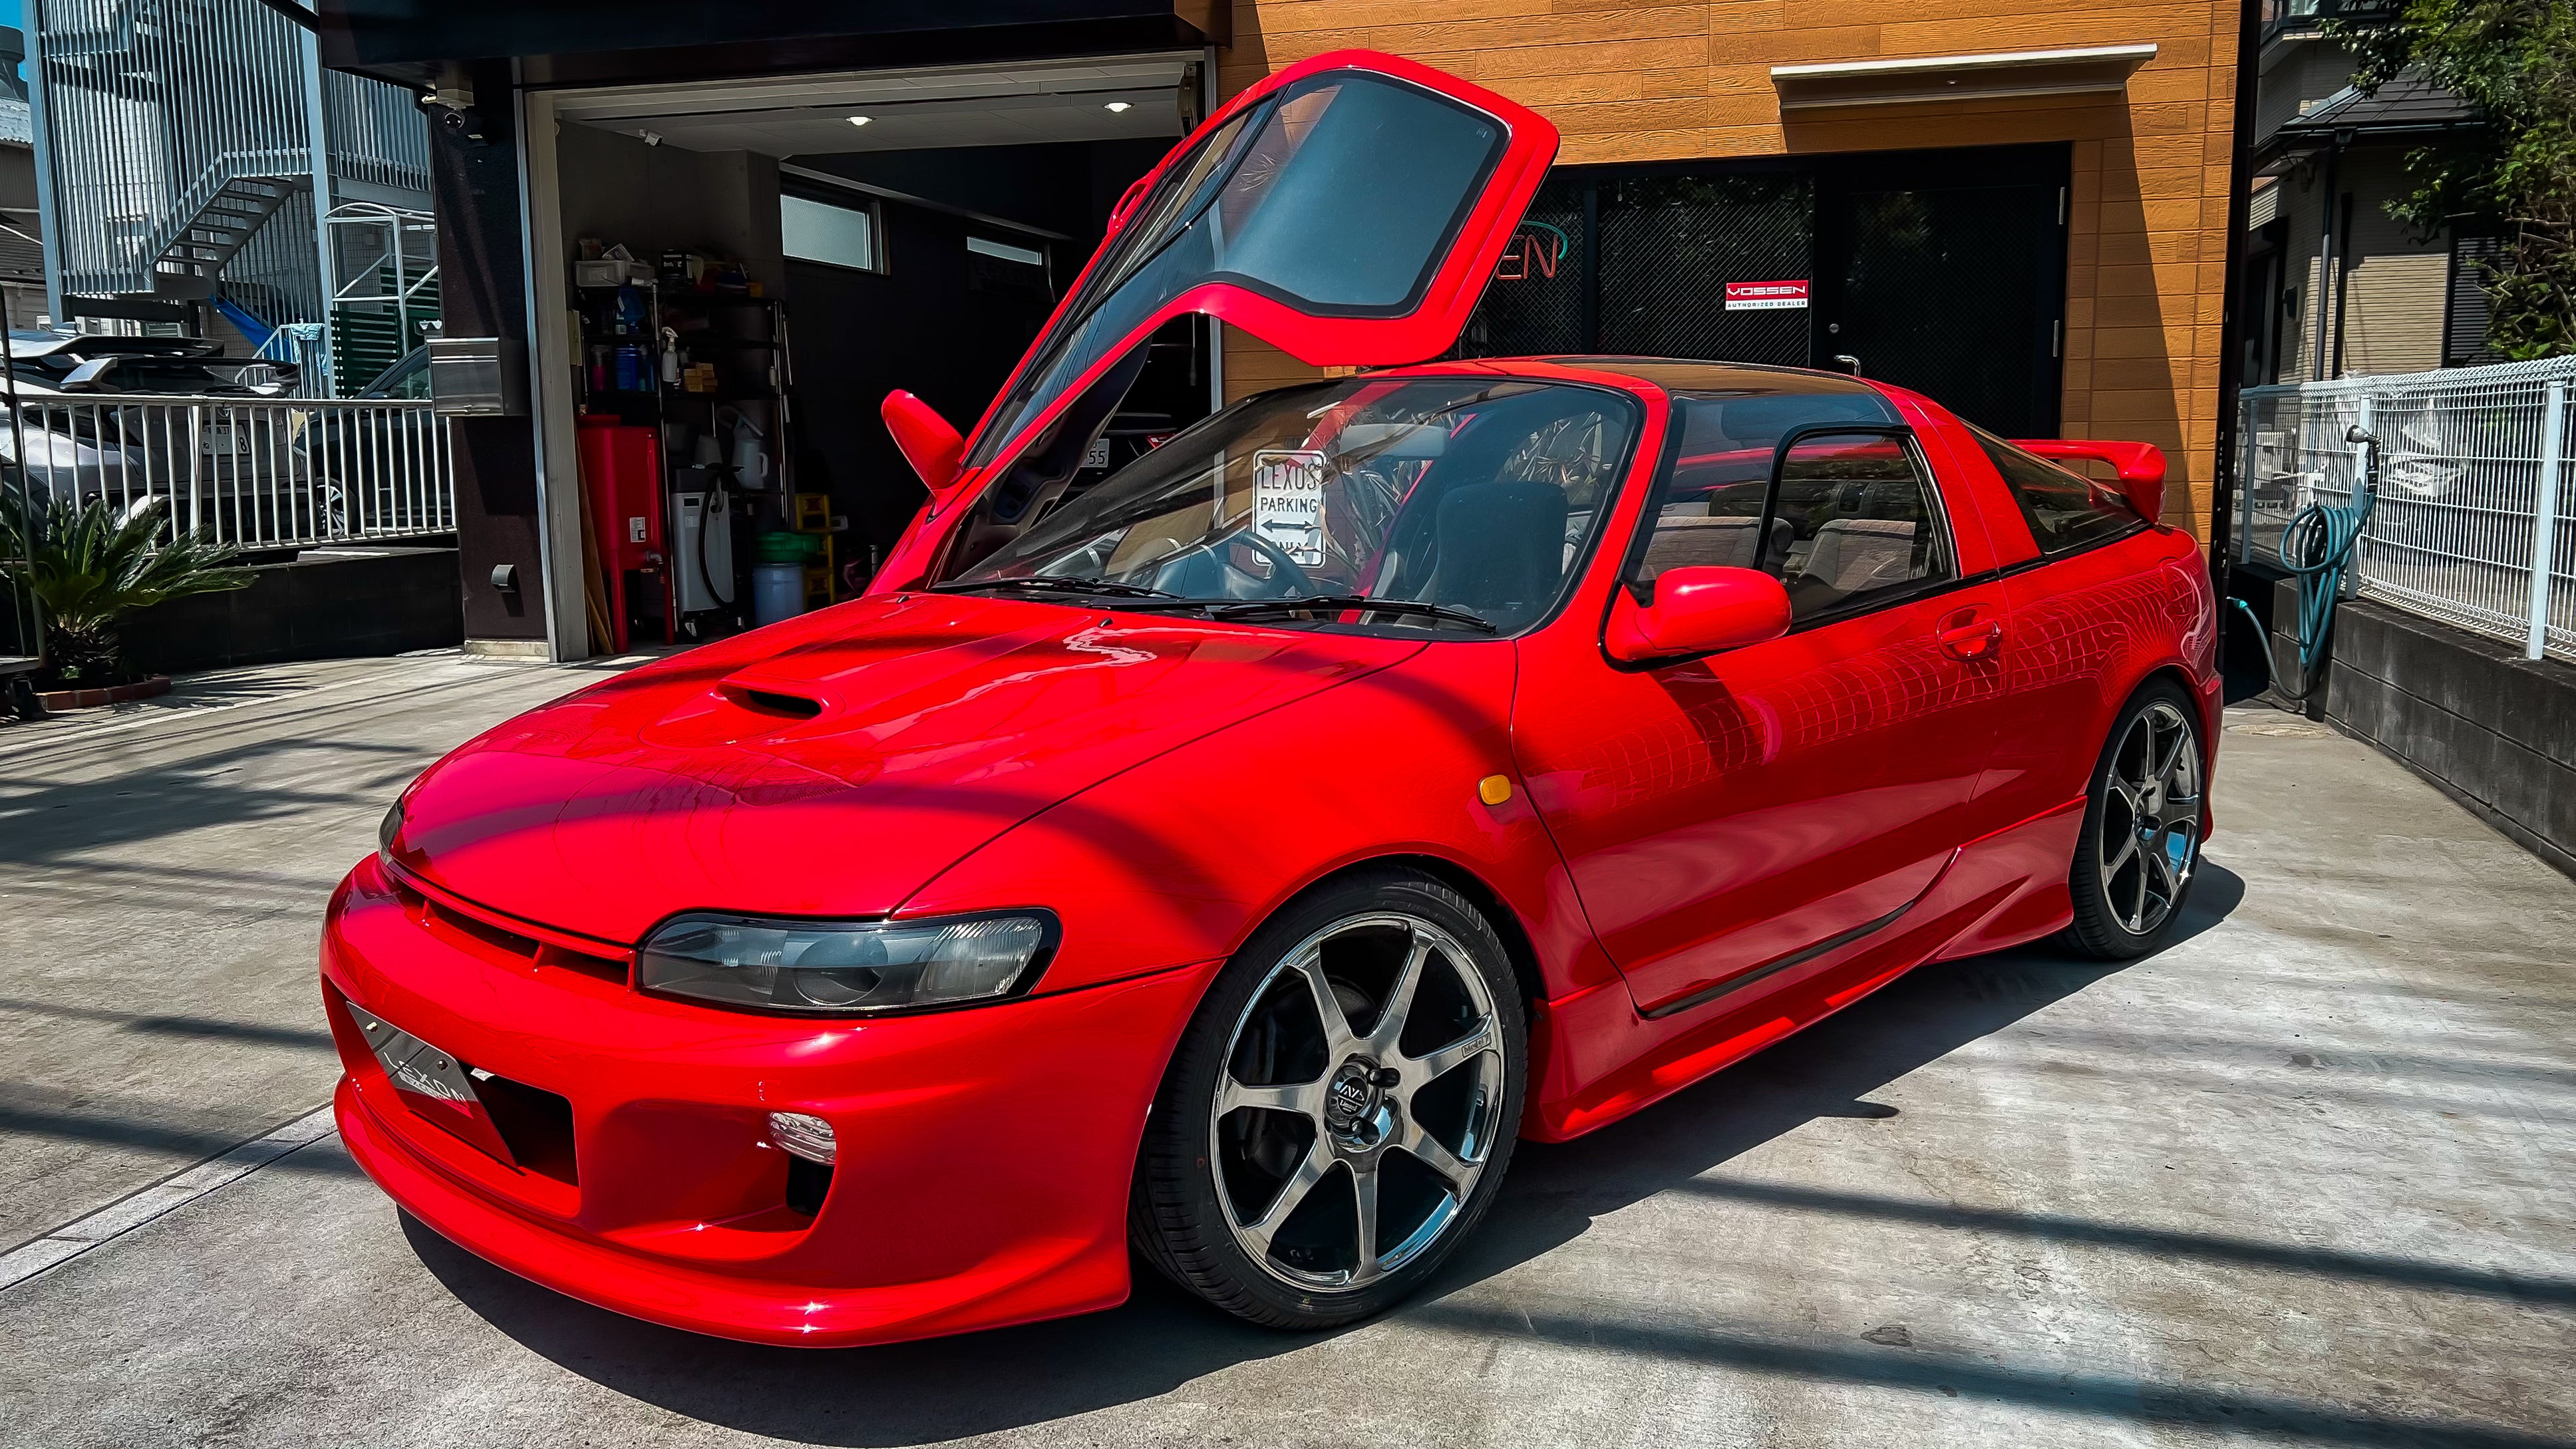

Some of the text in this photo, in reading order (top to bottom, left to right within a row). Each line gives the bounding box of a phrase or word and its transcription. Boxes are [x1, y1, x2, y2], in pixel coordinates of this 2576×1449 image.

[1495, 234, 1558, 279] EN
[1727, 285, 1806, 296] VOSSEN
[1261, 462, 1316, 491] LEXUS
[1261, 497, 1317, 513] PARKING
[1271, 542, 1309, 557] NLY
